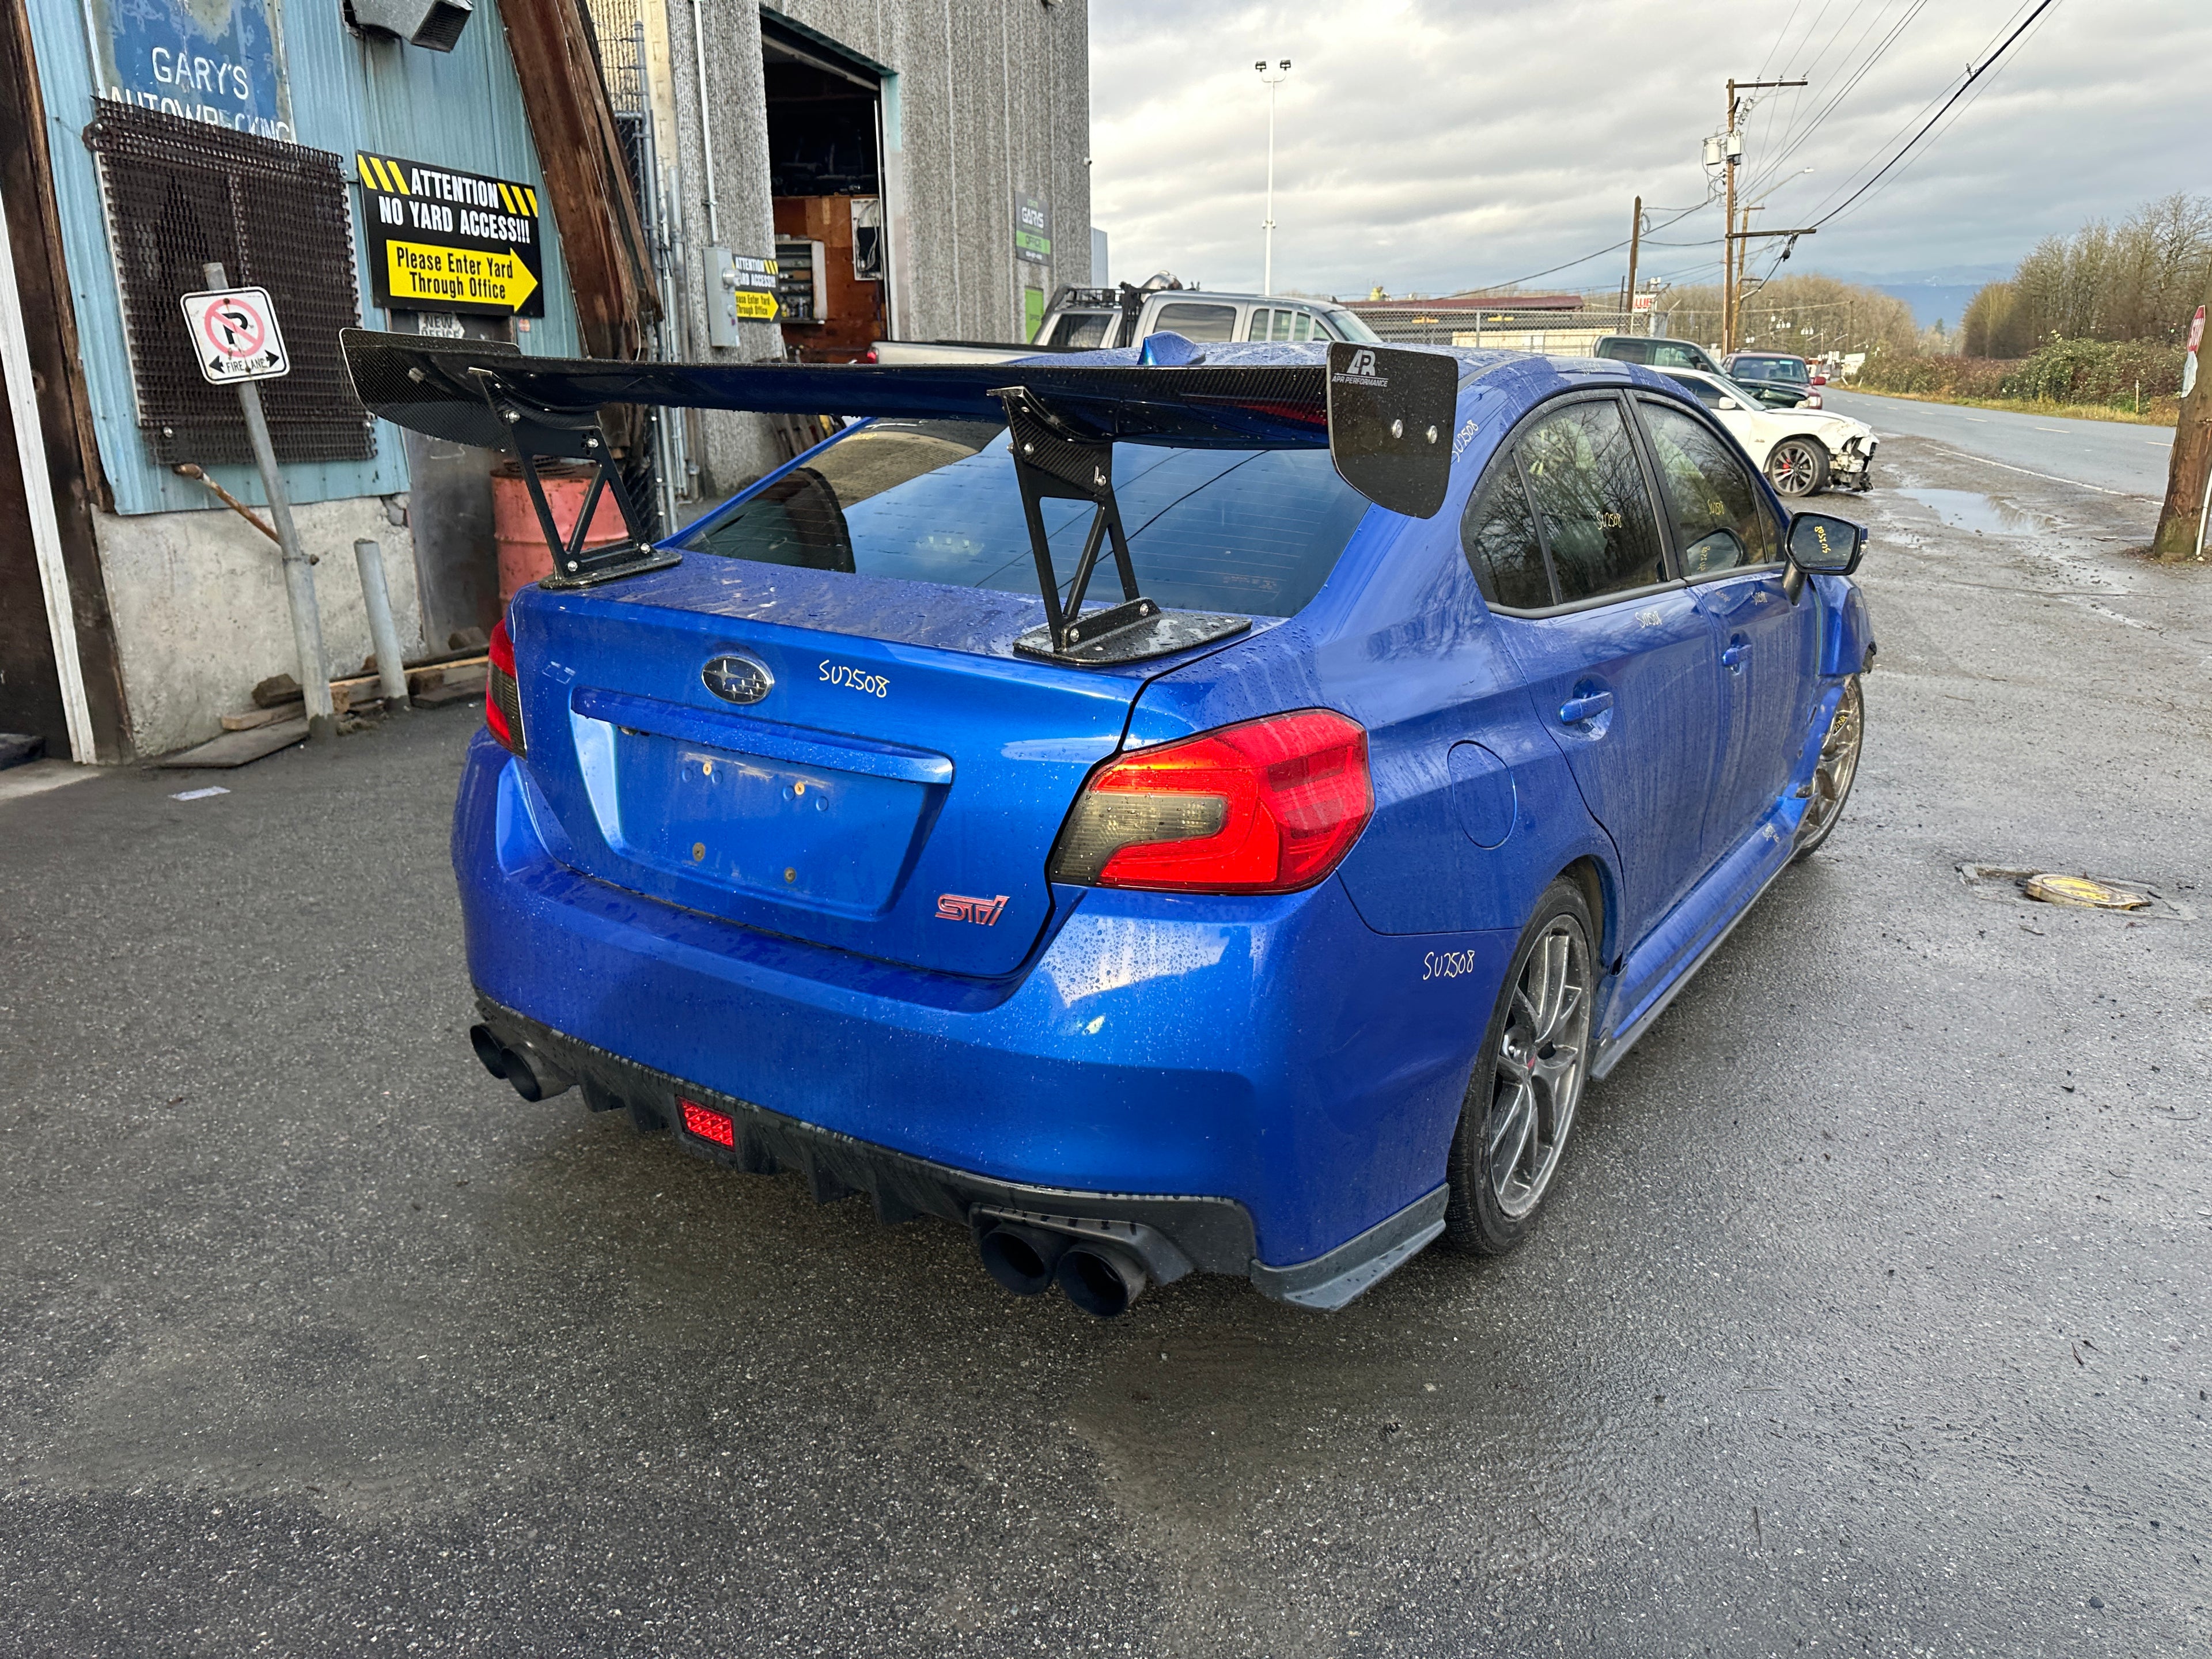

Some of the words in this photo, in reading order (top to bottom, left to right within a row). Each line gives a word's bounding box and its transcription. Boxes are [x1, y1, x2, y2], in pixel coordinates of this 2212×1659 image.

[152, 47, 249, 100] GARY'S
[411, 168, 499, 209] ATTENTION
[378, 195, 403, 226] NO
[409, 200, 453, 232] YARD
[460, 209, 530, 244] ACCESS!!!
[396, 247, 442, 271] Please
[448, 252, 481, 275] Enter
[487, 257, 513, 278] Yard
[736, 257, 765, 272] ATTENTION
[410, 272, 464, 298] Through
[469, 277, 505, 299] Office
[425, 315, 453, 328] NEW
[226, 361, 244, 373] FIRE
[1332, 375, 1345, 383] APR
[1345, 377, 1388, 387] PERFORMANCE
[1596, 511, 1622, 530] SU2508
[1814, 525, 1831, 554] SU2508
[819, 659, 890, 698] SU2508
[1423, 949, 1475, 980] SU2508
